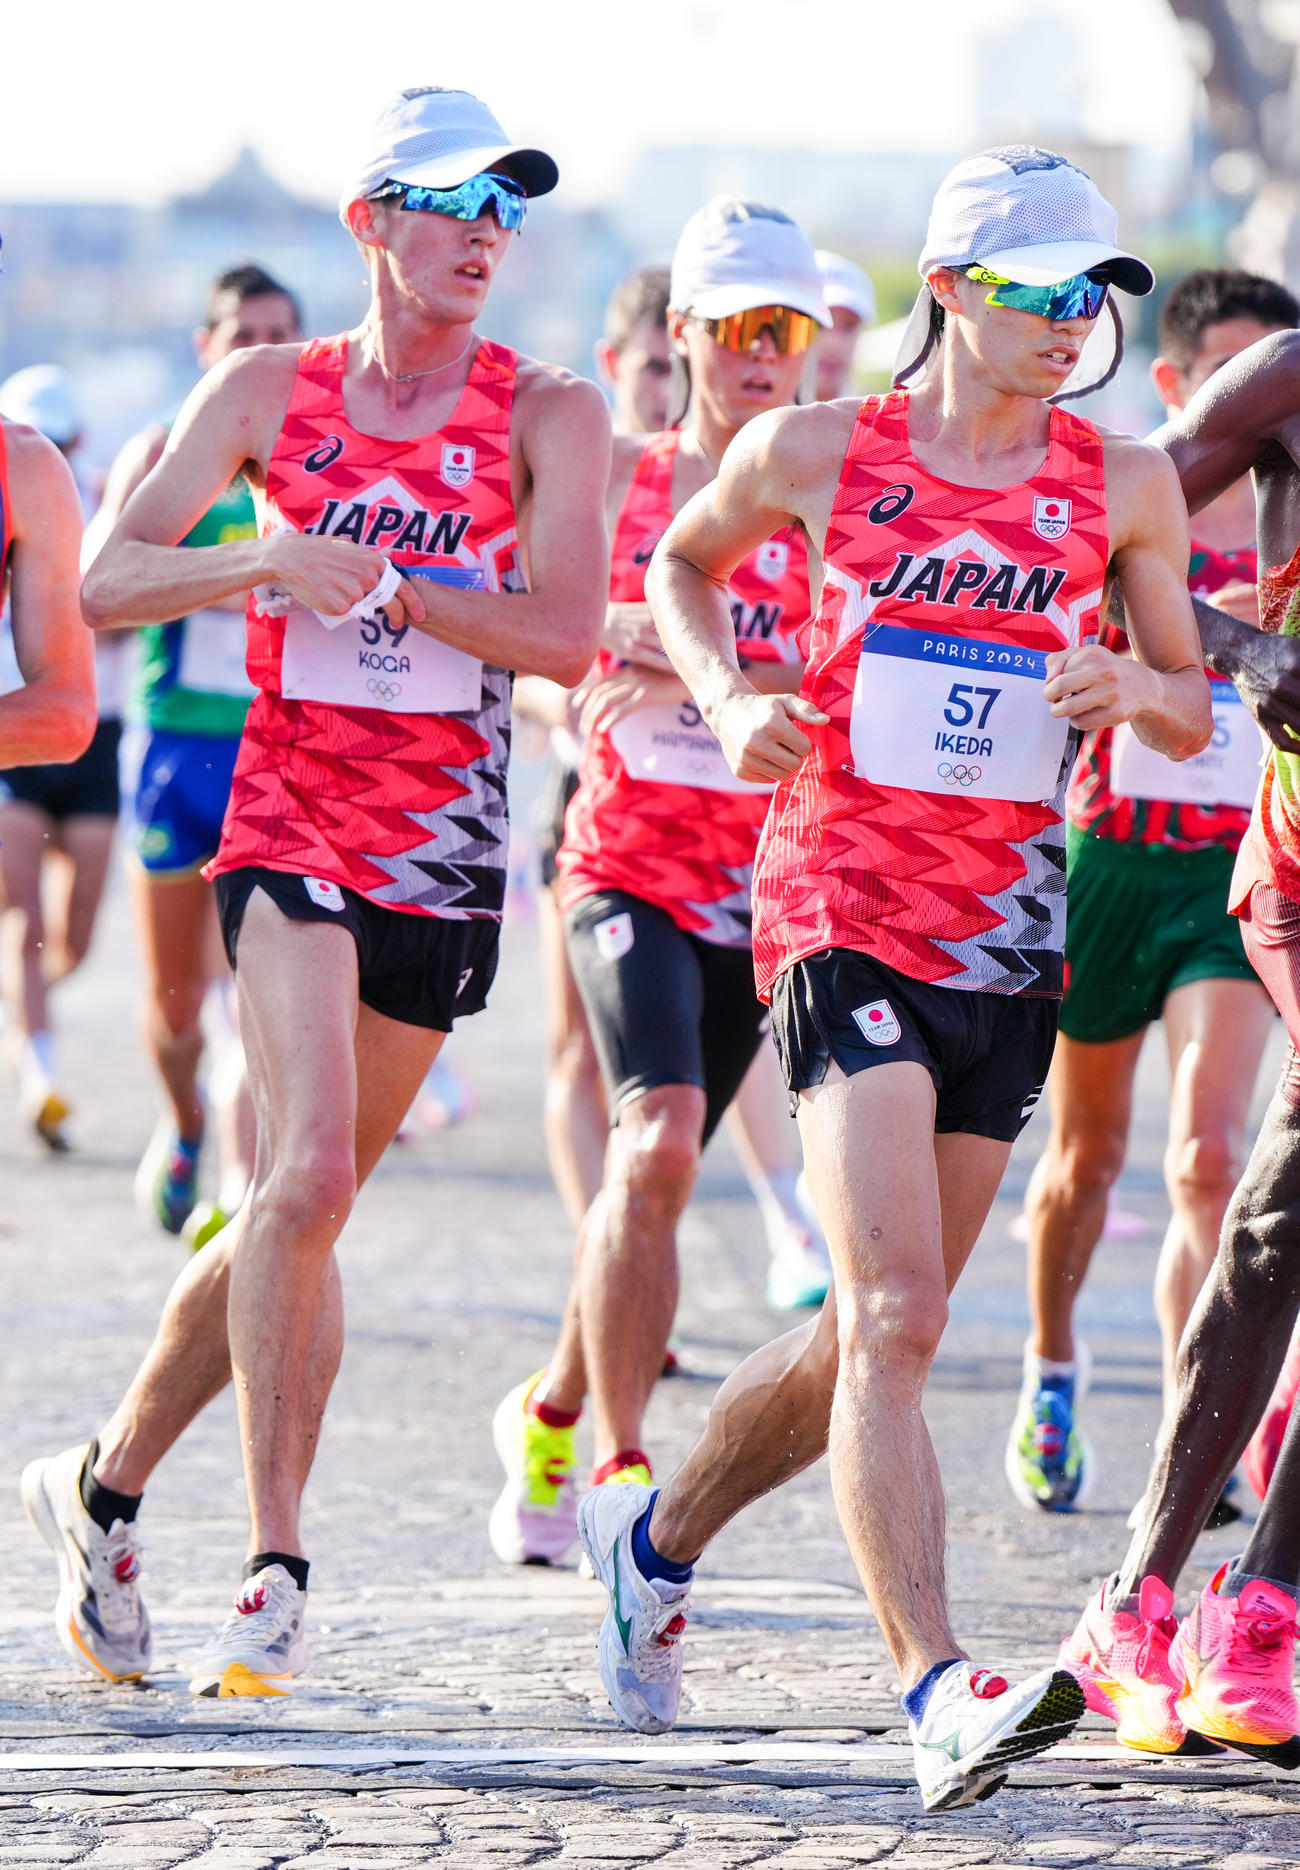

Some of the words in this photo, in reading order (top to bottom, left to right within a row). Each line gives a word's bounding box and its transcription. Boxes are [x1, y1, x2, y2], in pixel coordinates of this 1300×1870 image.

[304, 499, 473, 555] JAPAN
[869, 552, 1067, 614] JAPAN
[359, 650, 411, 673] KOGA
[986, 650, 1036, 670] 2024
[943, 682, 1003, 730] 57
[934, 731, 994, 757] IKEDA
